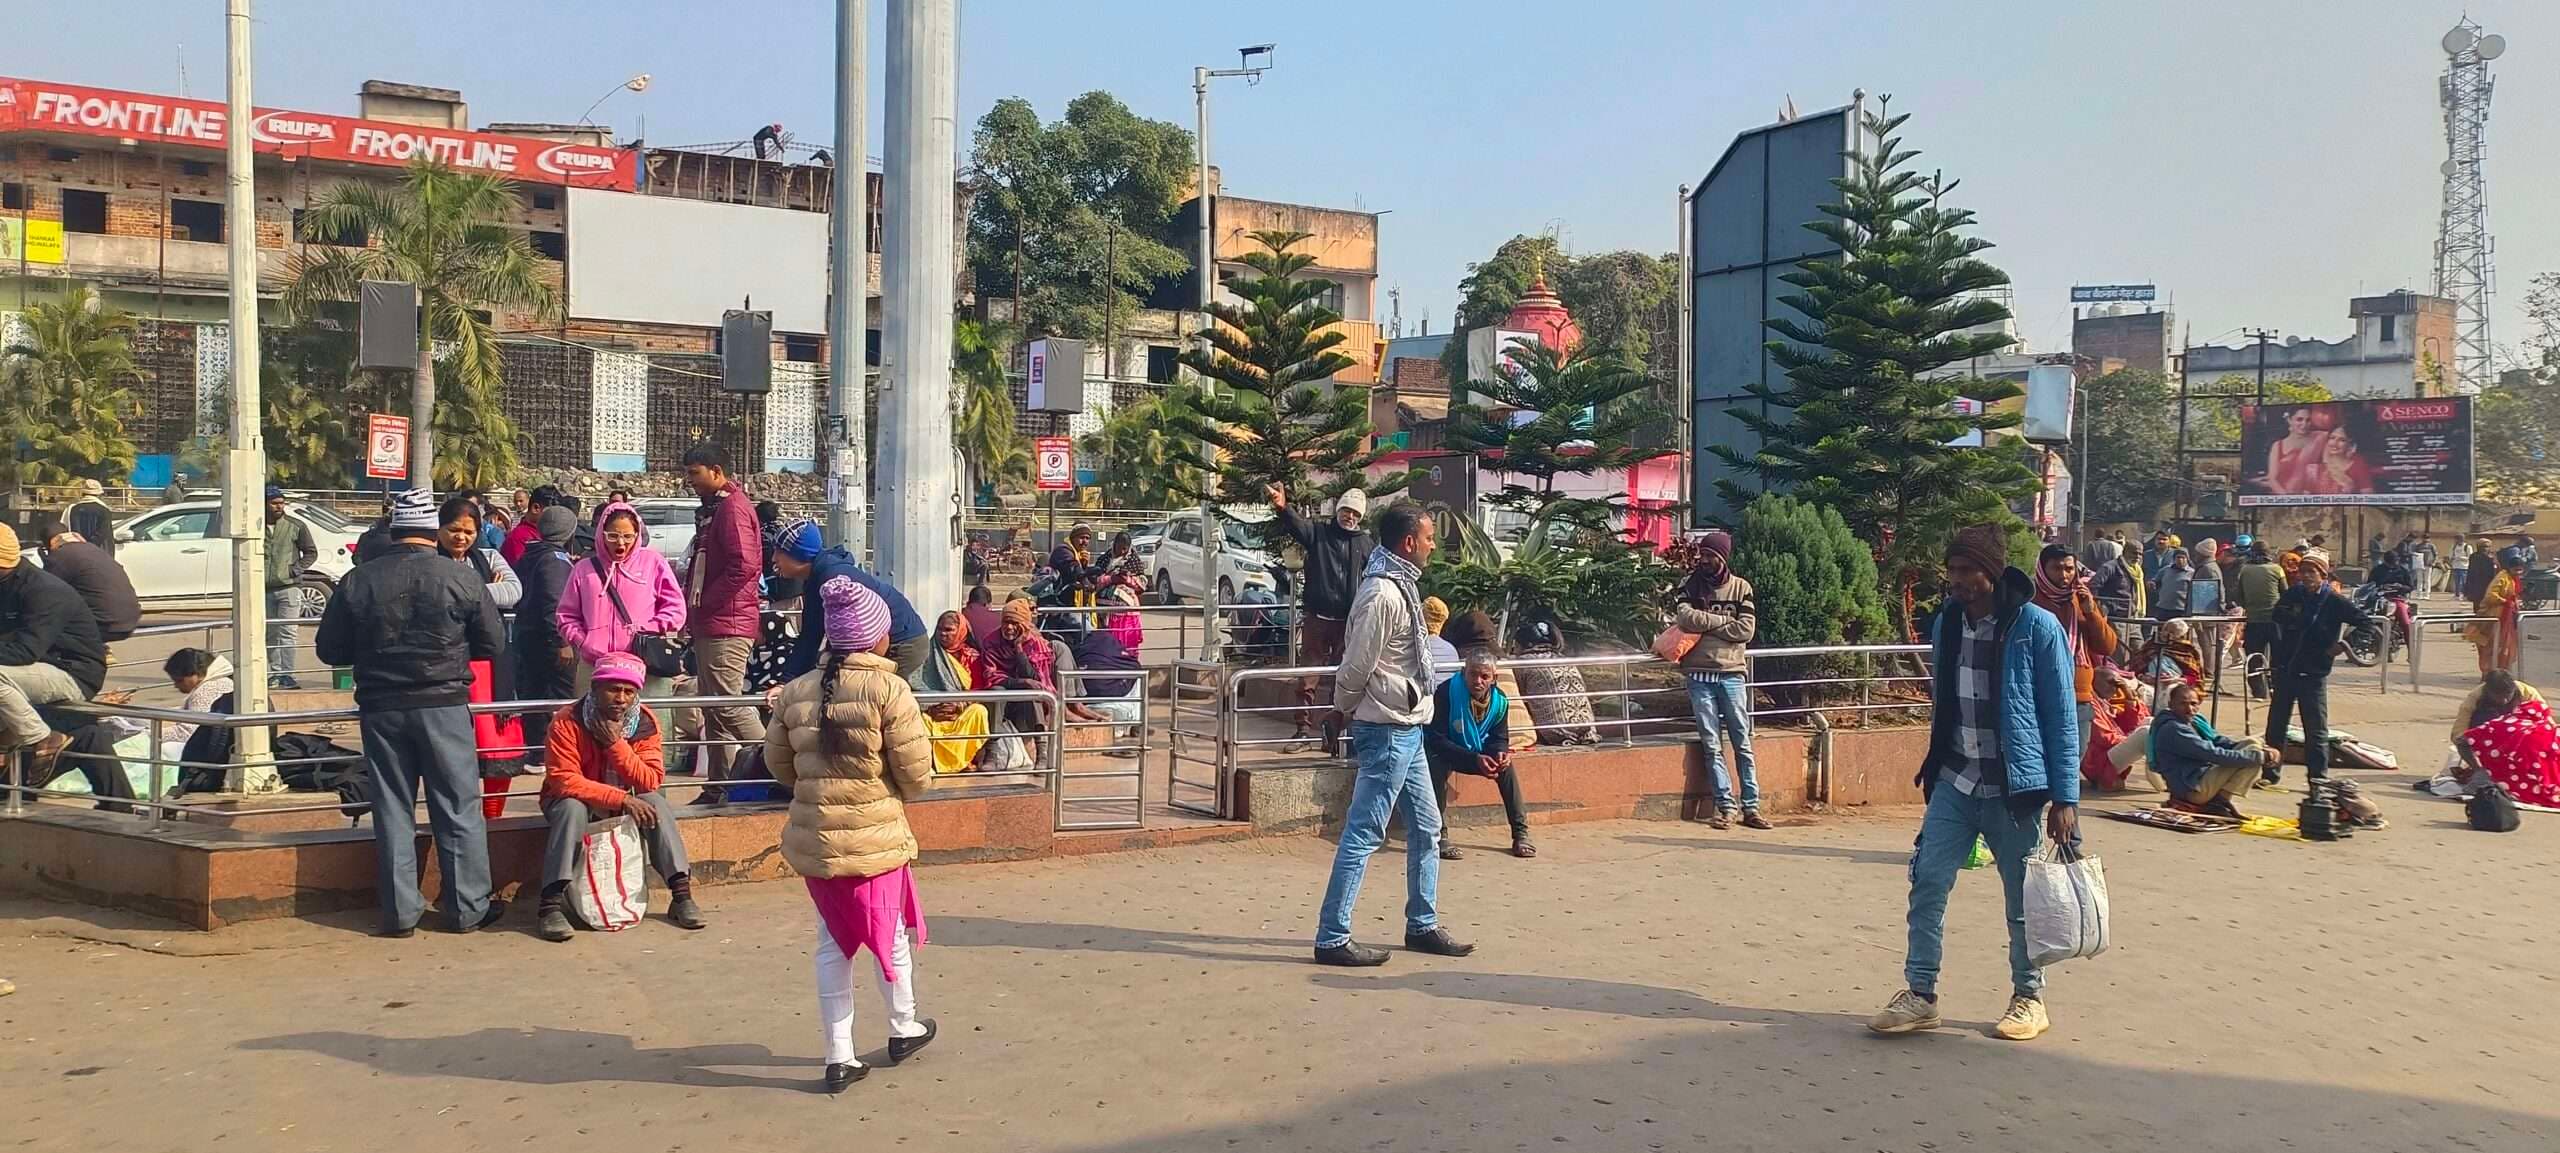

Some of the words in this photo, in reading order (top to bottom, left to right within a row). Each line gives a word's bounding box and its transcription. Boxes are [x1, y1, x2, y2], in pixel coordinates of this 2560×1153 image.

[33, 91, 227, 141] FRONTLINE
[269, 118, 335, 139] RUPA
[348, 128, 520, 172] FRONTLINE
[555, 151, 617, 171] RUPA
[2395, 405, 2449, 416] SENCO
